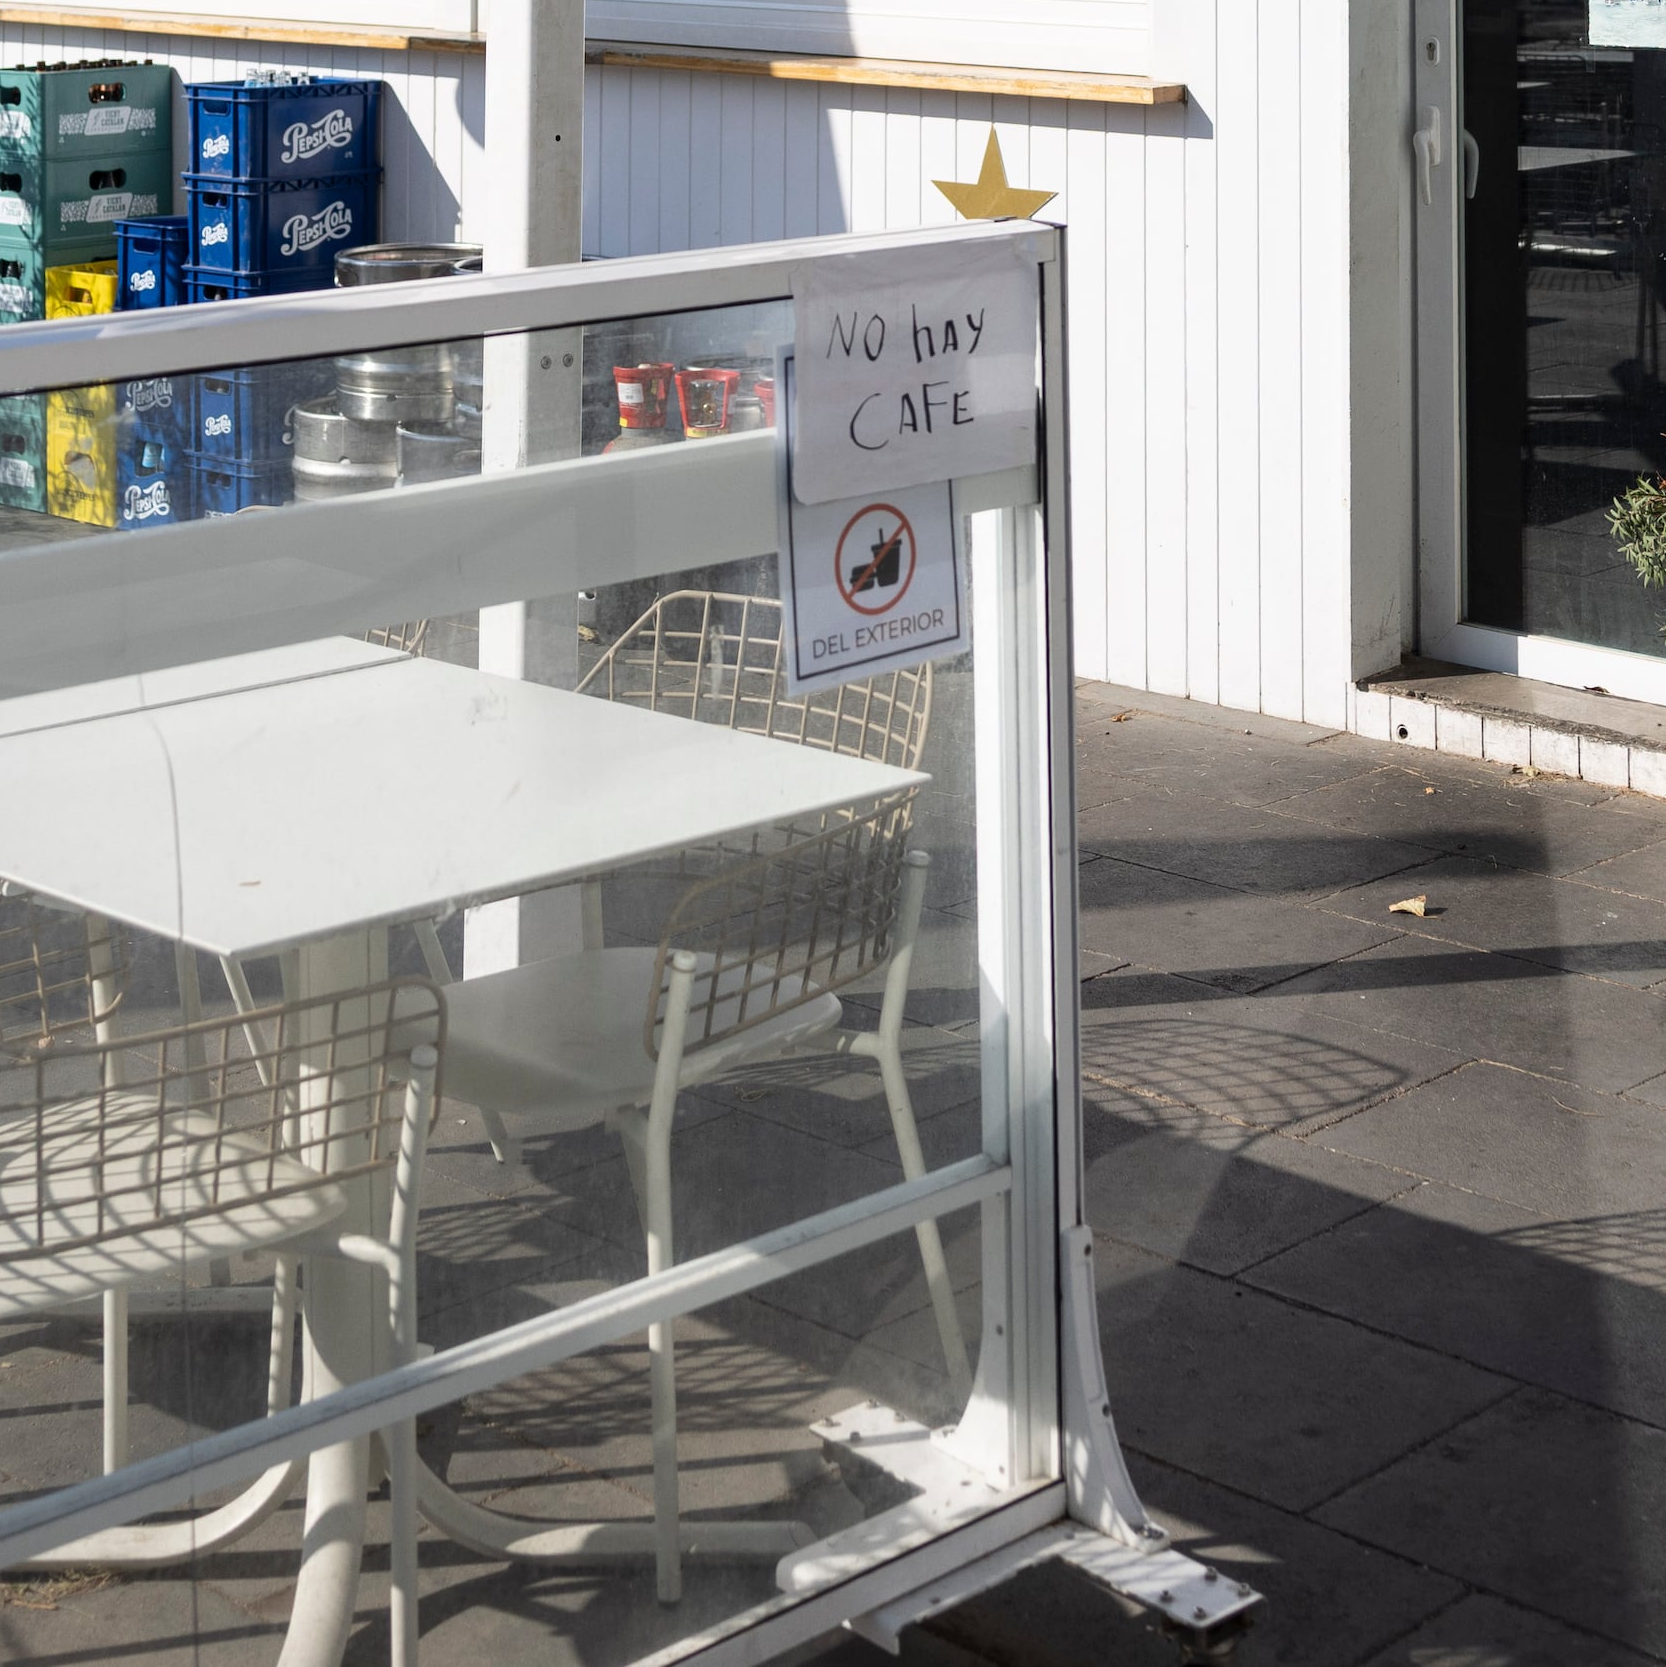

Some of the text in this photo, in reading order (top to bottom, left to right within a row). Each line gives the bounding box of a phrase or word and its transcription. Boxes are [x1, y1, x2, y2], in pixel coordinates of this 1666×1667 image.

[826, 311, 886, 361] NO
[849, 380, 975, 451] CAFE
[812, 608, 945, 660] DEL EXTERIOR
